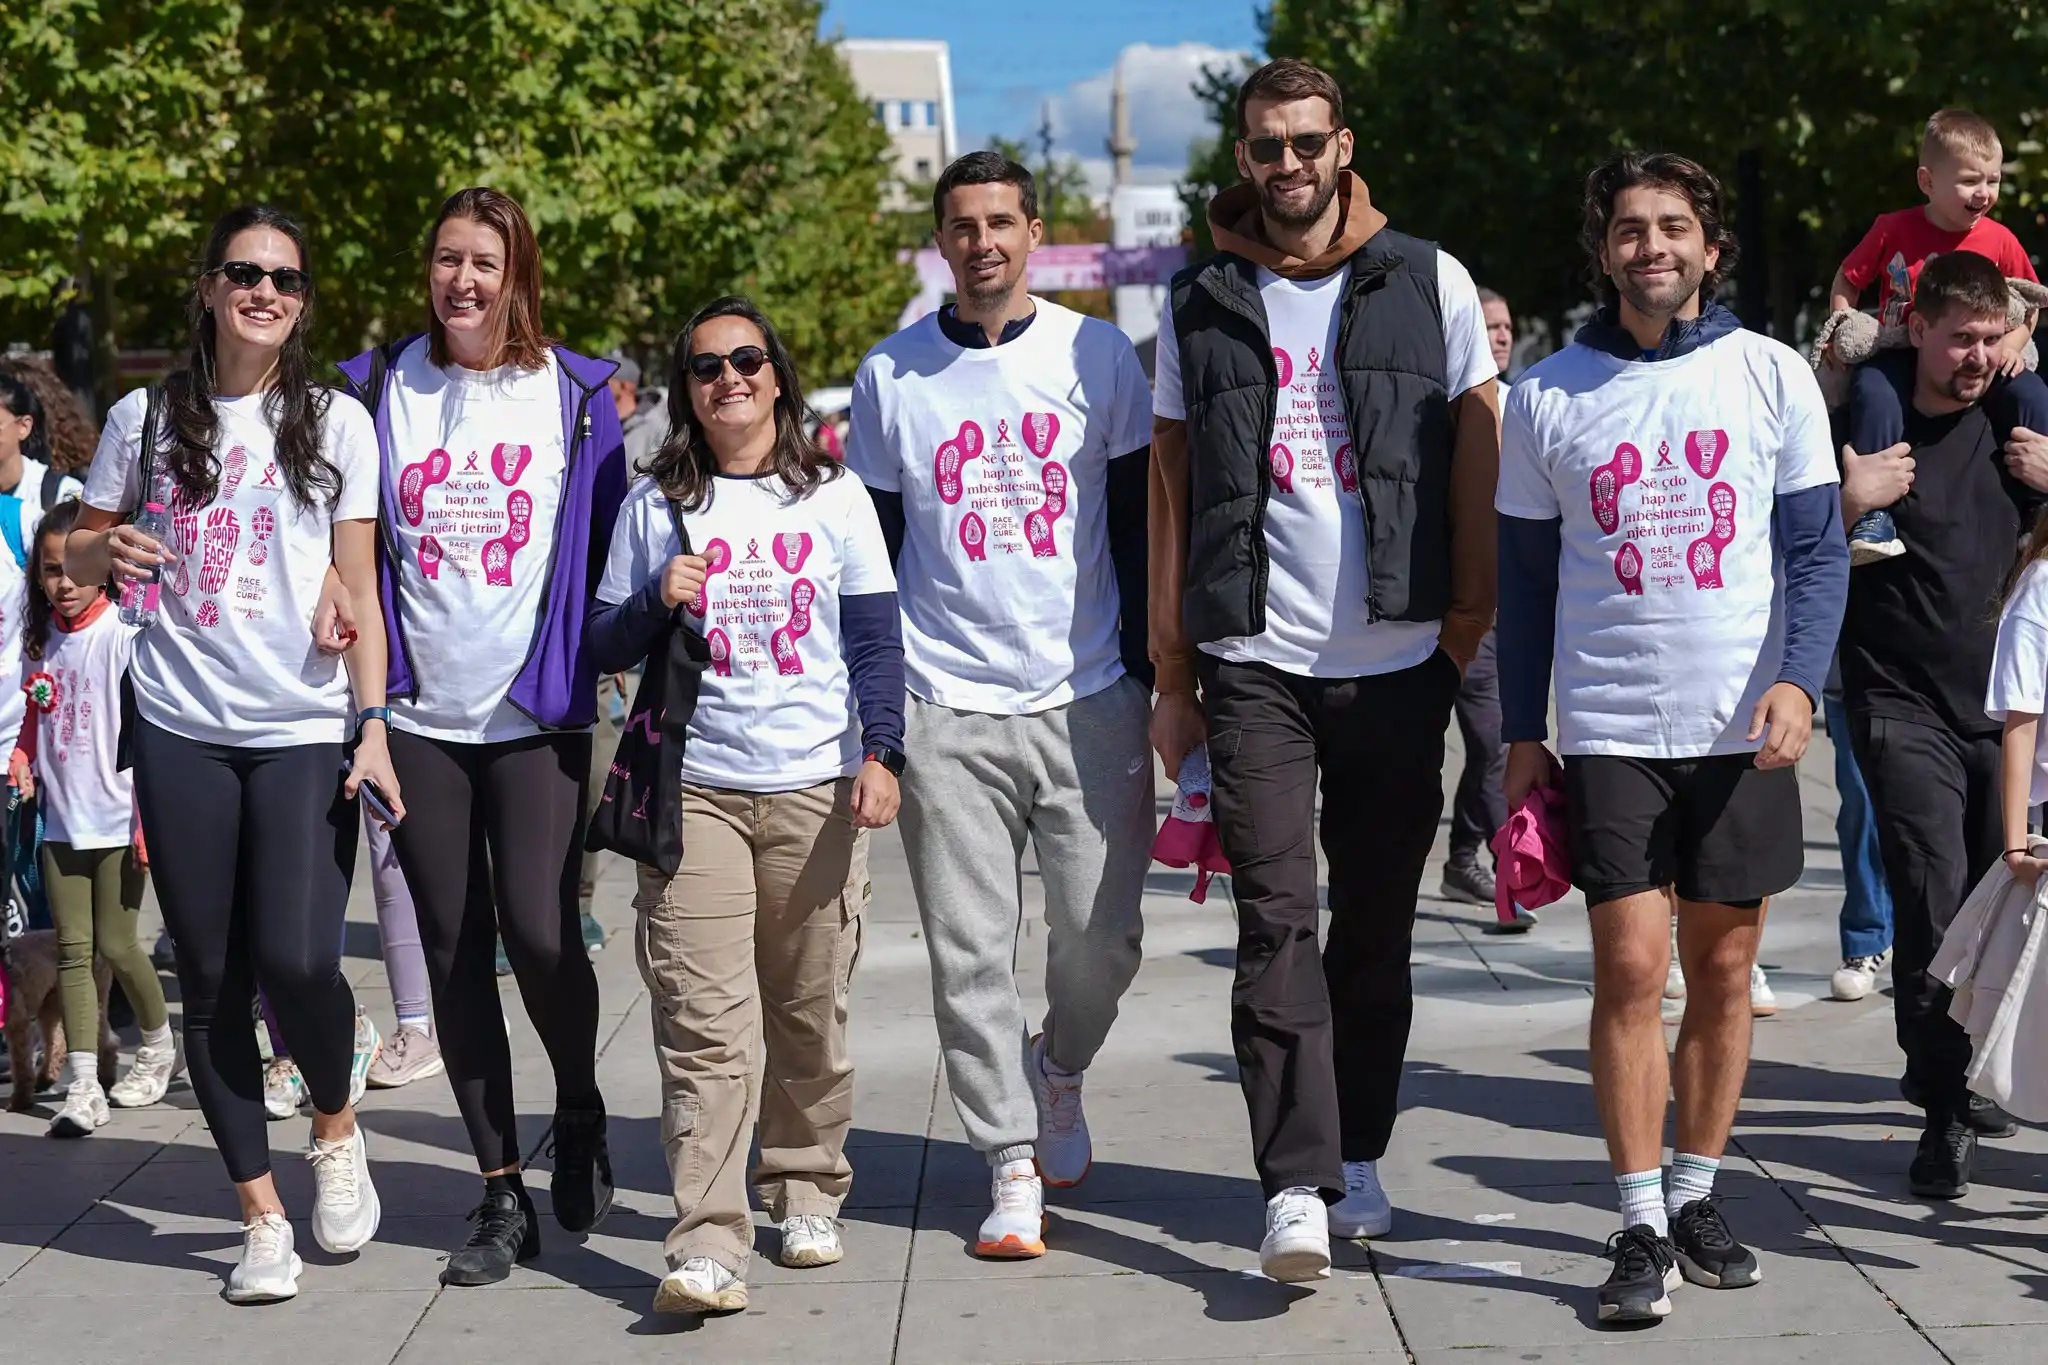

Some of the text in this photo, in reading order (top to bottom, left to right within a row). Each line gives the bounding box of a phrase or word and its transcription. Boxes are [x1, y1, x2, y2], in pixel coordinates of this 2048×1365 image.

[1290, 381, 1336, 396] Në çdo
[1292, 399, 1336, 411] hap ne
[1279, 428, 1308, 441] njëri
[981, 452, 1024, 465] Në çdo
[983, 468, 1024, 480] hap ne
[445, 480, 490, 492] Në çdo
[967, 481, 1040, 495] mbështesim
[1639, 475, 1687, 491] Në çdo
[445, 495, 489, 506] hap ne
[971, 498, 998, 510] njëri
[1641, 492, 1687, 507] hap ne
[207, 507, 241, 528] WE
[428, 508, 505, 520] mbështesim
[1624, 506, 1707, 524] mbështesim
[173, 515, 199, 556] STEP
[430, 523, 457, 535] njëri
[1626, 525, 1657, 540] njëri
[203, 526, 241, 550] SUPPORT
[448, 541, 470, 549] RACE
[1650, 545, 1673, 554] RACE
[203, 543, 235, 568] EACH
[1650, 552, 1682, 561] FOR THE
[198, 565, 229, 595] OTHER
[728, 568, 773, 580] Në çdo
[238, 576, 261, 586] RACE
[729, 583, 773, 595] hap ne
[712, 597, 788, 610] mbështesim
[716, 613, 744, 627] njëri
